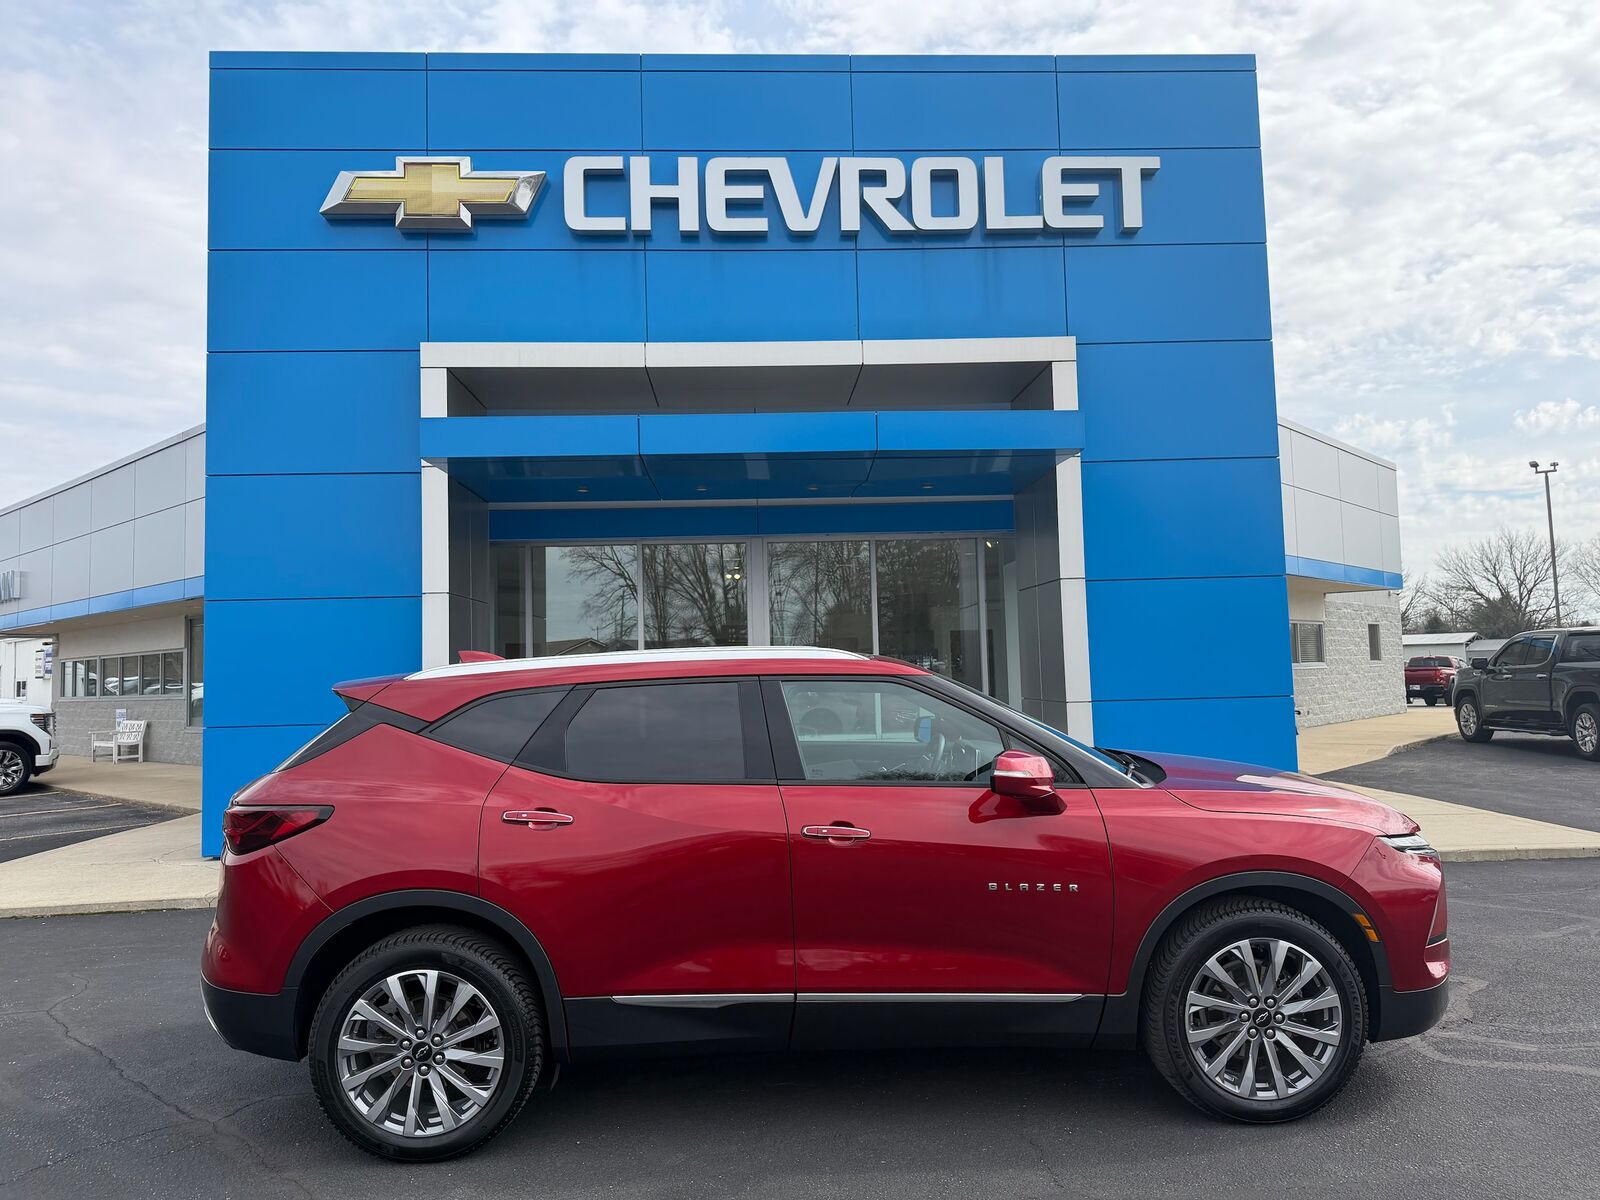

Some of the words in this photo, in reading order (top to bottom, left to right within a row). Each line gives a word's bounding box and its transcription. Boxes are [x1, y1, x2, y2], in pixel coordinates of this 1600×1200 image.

[563, 155, 1161, 235] CHEVROLET
[988, 882, 1079, 892] BLAZER
[1167, 998, 1183, 1059] MICHELIN
[1346, 979, 1361, 1041] MICHELIN
